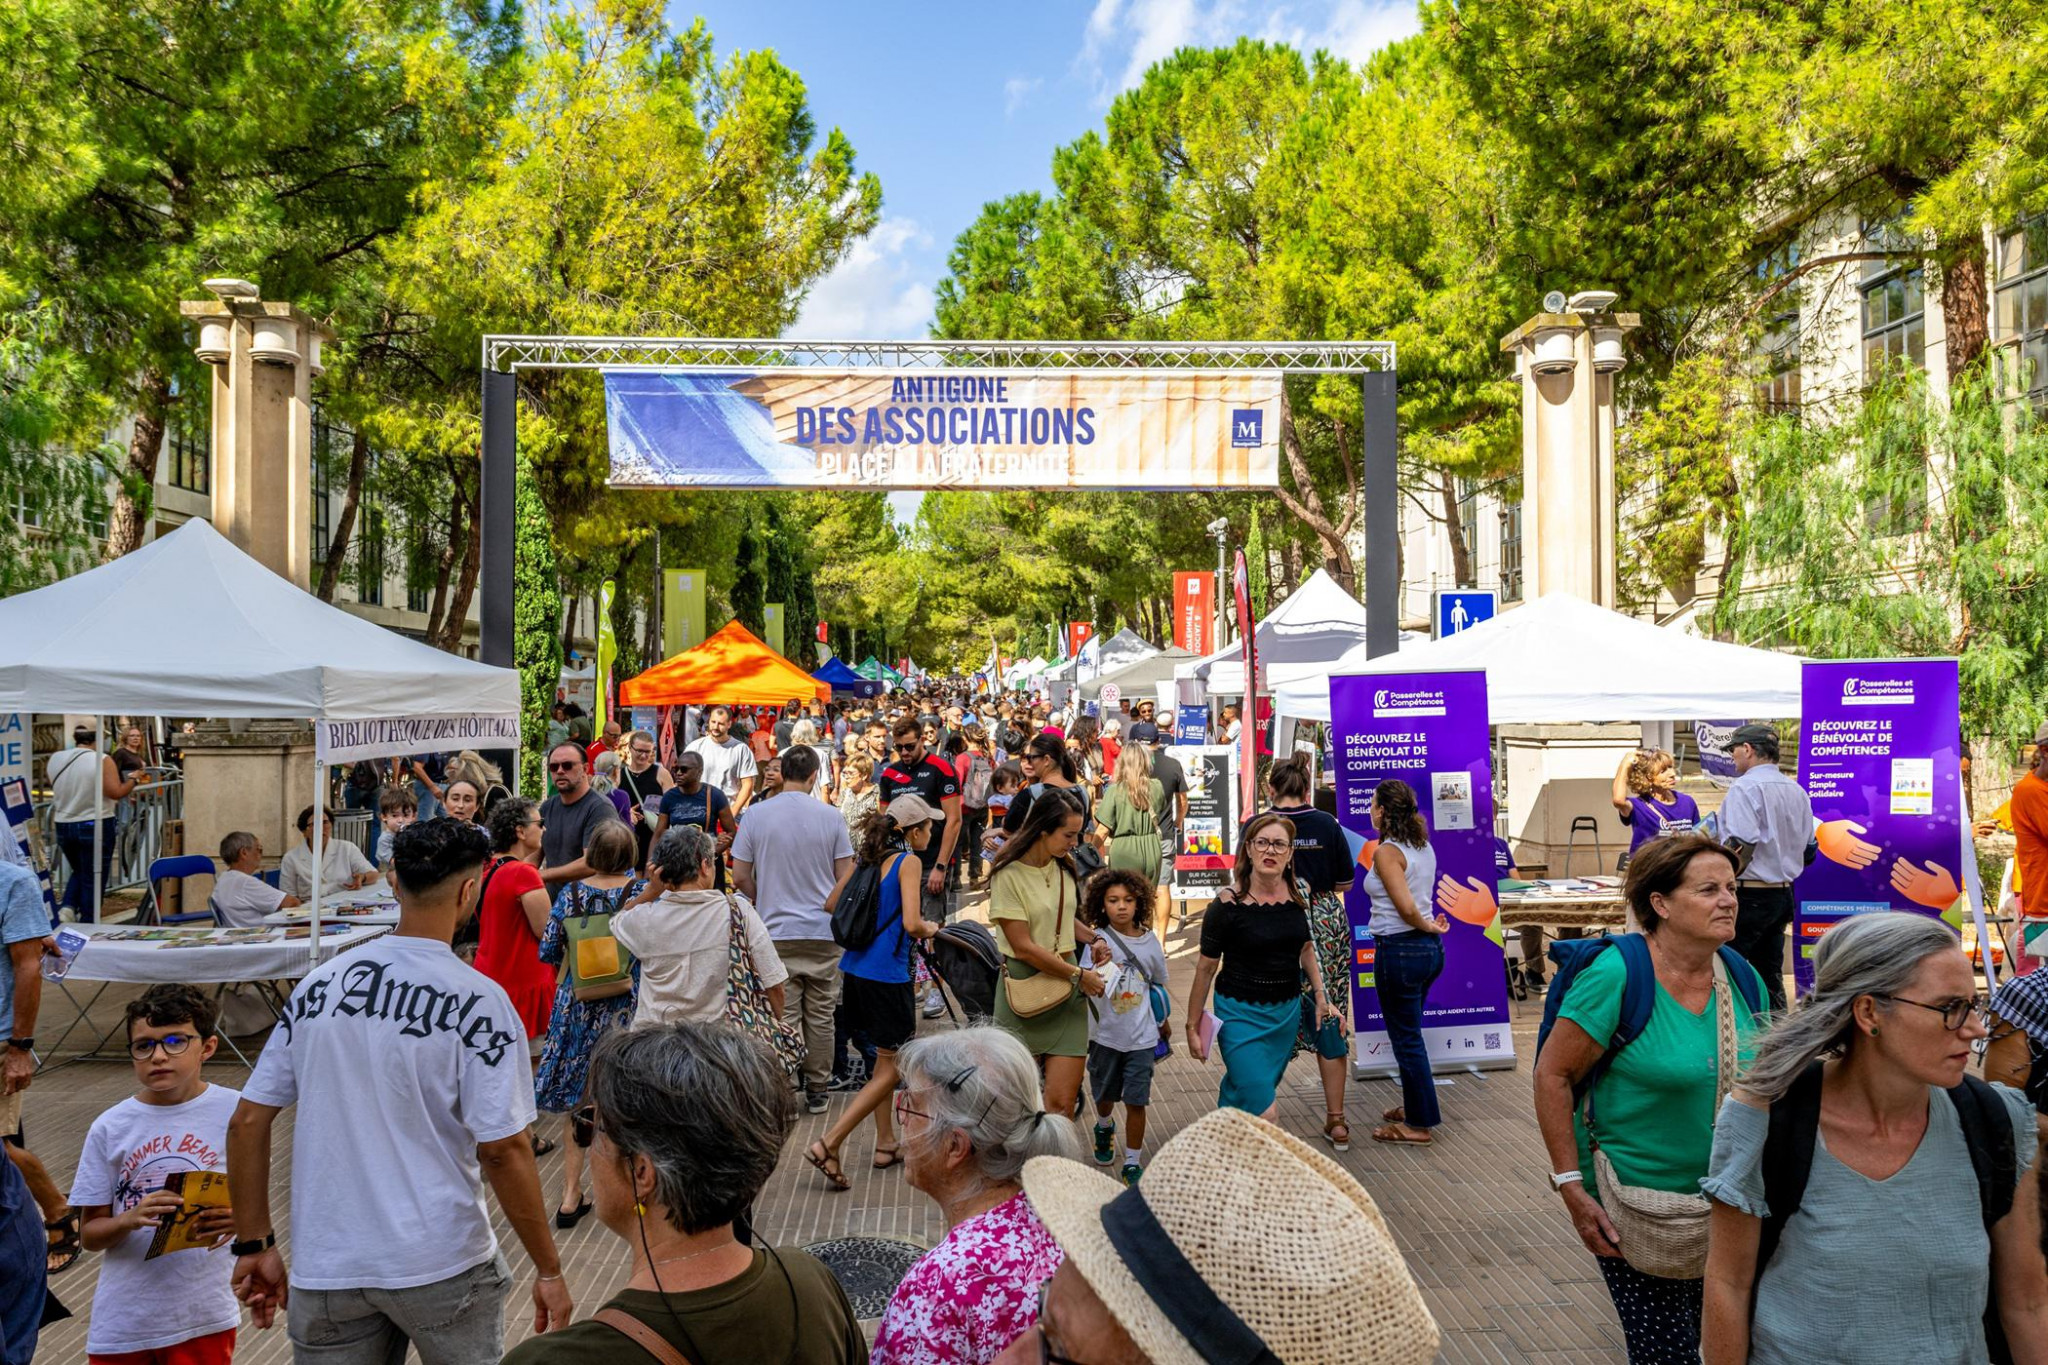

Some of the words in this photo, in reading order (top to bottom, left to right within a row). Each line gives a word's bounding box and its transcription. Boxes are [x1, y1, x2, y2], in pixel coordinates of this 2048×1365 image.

[891, 376, 1008, 403] ANTIGONE
[796, 406, 856, 445] DES
[863, 406, 1096, 446] ASSOCIATIONS
[1237, 421, 1257, 438] M
[821, 451, 888, 480] PLACE
[912, 451, 937, 480] LA
[1860, 679, 1903, 687] Passerelles
[1904, 679, 1914, 687] et
[1390, 691, 1433, 700] Passerelles
[1860, 687, 1914, 696] Compétences
[1390, 698, 1445, 708] Compétences
[328, 716, 435, 749] BIBLIOTHÈQUE
[433, 717, 458, 739] DES
[458, 713, 518, 738] HÔPITAUX
[1812, 719, 1877, 732] DÉCOUVREZ
[1879, 720, 1892, 730] LE
[1345, 733, 1411, 745] DÉCOUVREZ
[1414, 733, 1427, 742] LE
[1811, 732, 1875, 744] BÉNÉVOLAT
[1878, 733, 1893, 742] DE
[1346, 745, 1410, 758] BÉNÉVOLAT
[1413, 746, 1428, 755] DE
[1810, 744, 1890, 757] COMPÉTENCES
[1347, 757, 1427, 771] COMPÉTENCES
[1809, 772, 1855, 780] Sur-mesure
[1809, 781, 1837, 790] Simple
[1808, 790, 1844, 798] Solidaire
[1349, 796, 1373, 806] Simpl
[1350, 806, 1371, 815] Solid
[1807, 904, 1854, 912] COMPÉTENCES
[331, 959, 517, 1068] Angeles
[120, 1135, 172, 1180] SUMMER
[176, 1133, 219, 1168] BEACH
